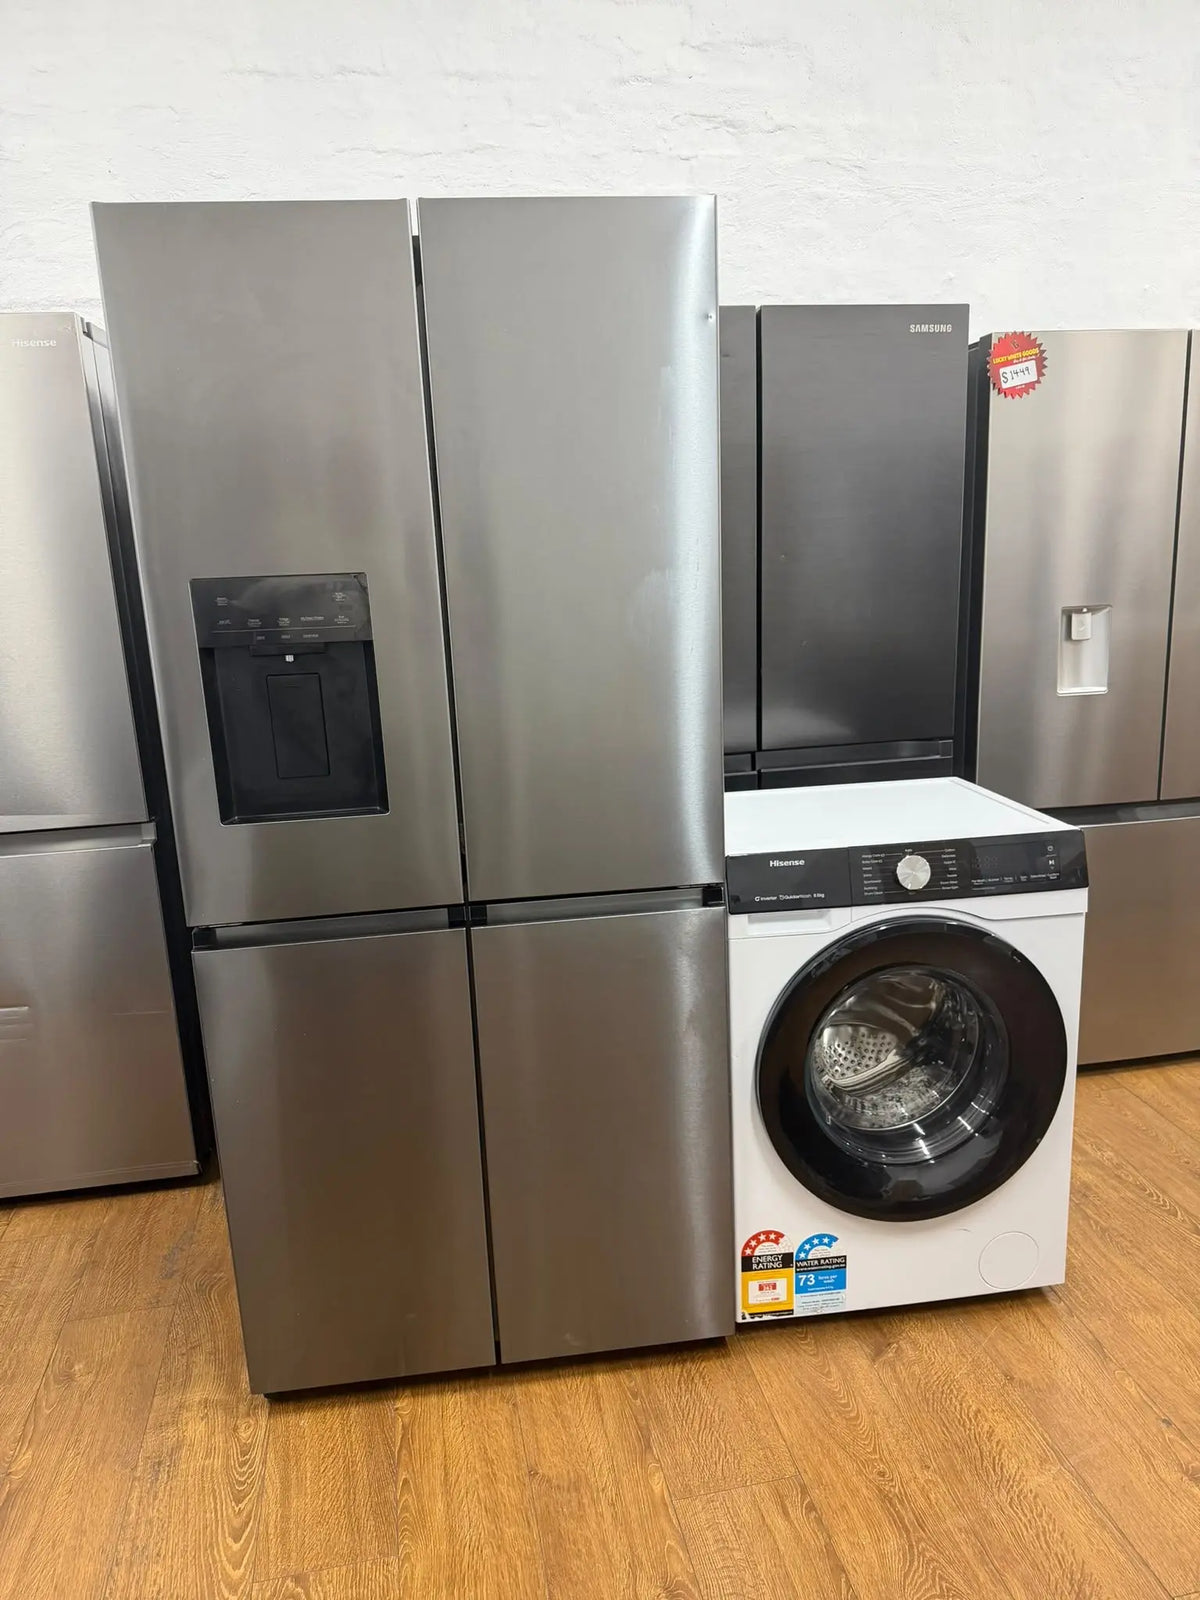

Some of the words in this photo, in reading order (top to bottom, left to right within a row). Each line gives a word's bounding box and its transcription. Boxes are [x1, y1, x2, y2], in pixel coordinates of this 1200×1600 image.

[910, 324, 952, 333] SAMSUNG
[11, 339, 57, 347] Hisense
[769, 858, 805, 868] Hisense
[752, 1254, 783, 1264] ENERGY
[796, 1259, 819, 1268] WATER
[820, 1257, 845, 1266] RATING
[752, 1261, 783, 1270] RATING
[798, 1273, 816, 1287] 73
